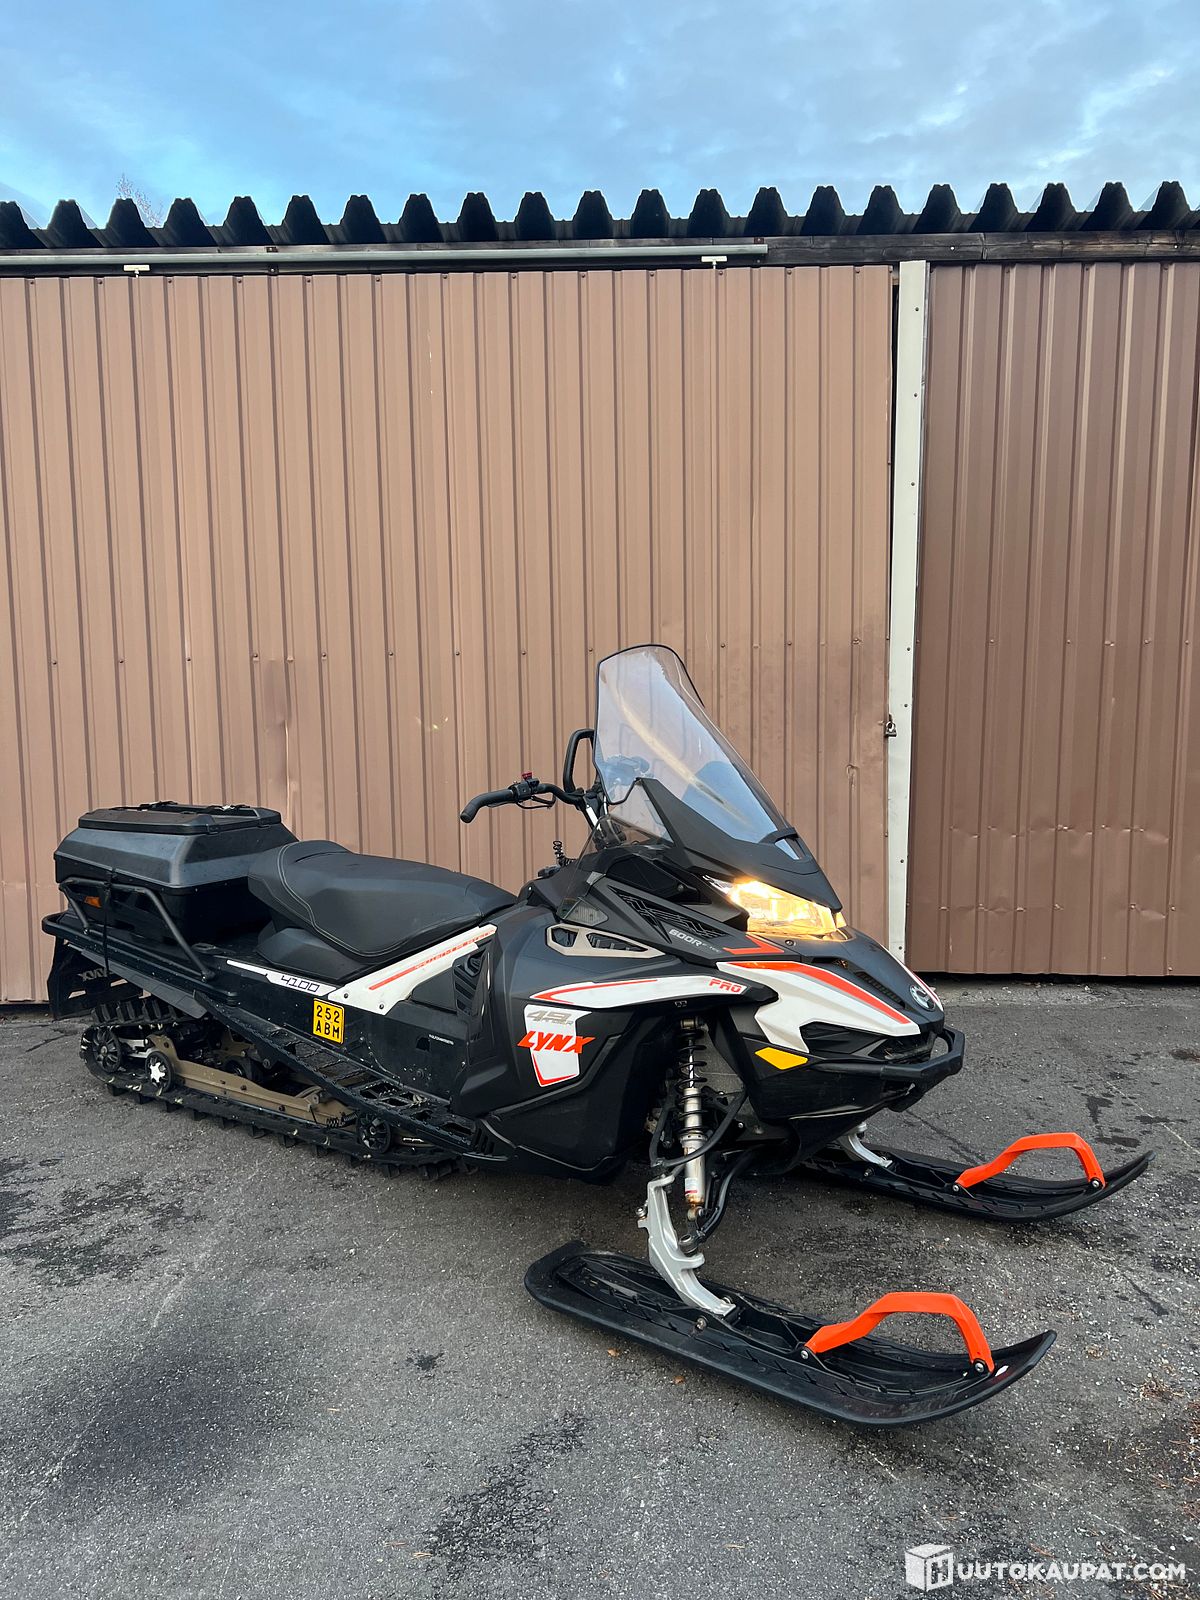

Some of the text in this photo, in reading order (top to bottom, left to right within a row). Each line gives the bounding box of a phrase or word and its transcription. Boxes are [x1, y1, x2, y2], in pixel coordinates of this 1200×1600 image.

[668, 928, 703, 948] 600R
[281, 975, 320, 993] 4100
[708, 978, 742, 993] PRO
[316, 1004, 341, 1024] 252
[315, 1020, 340, 1039] ABM
[516, 1030, 596, 1054] LYNX
